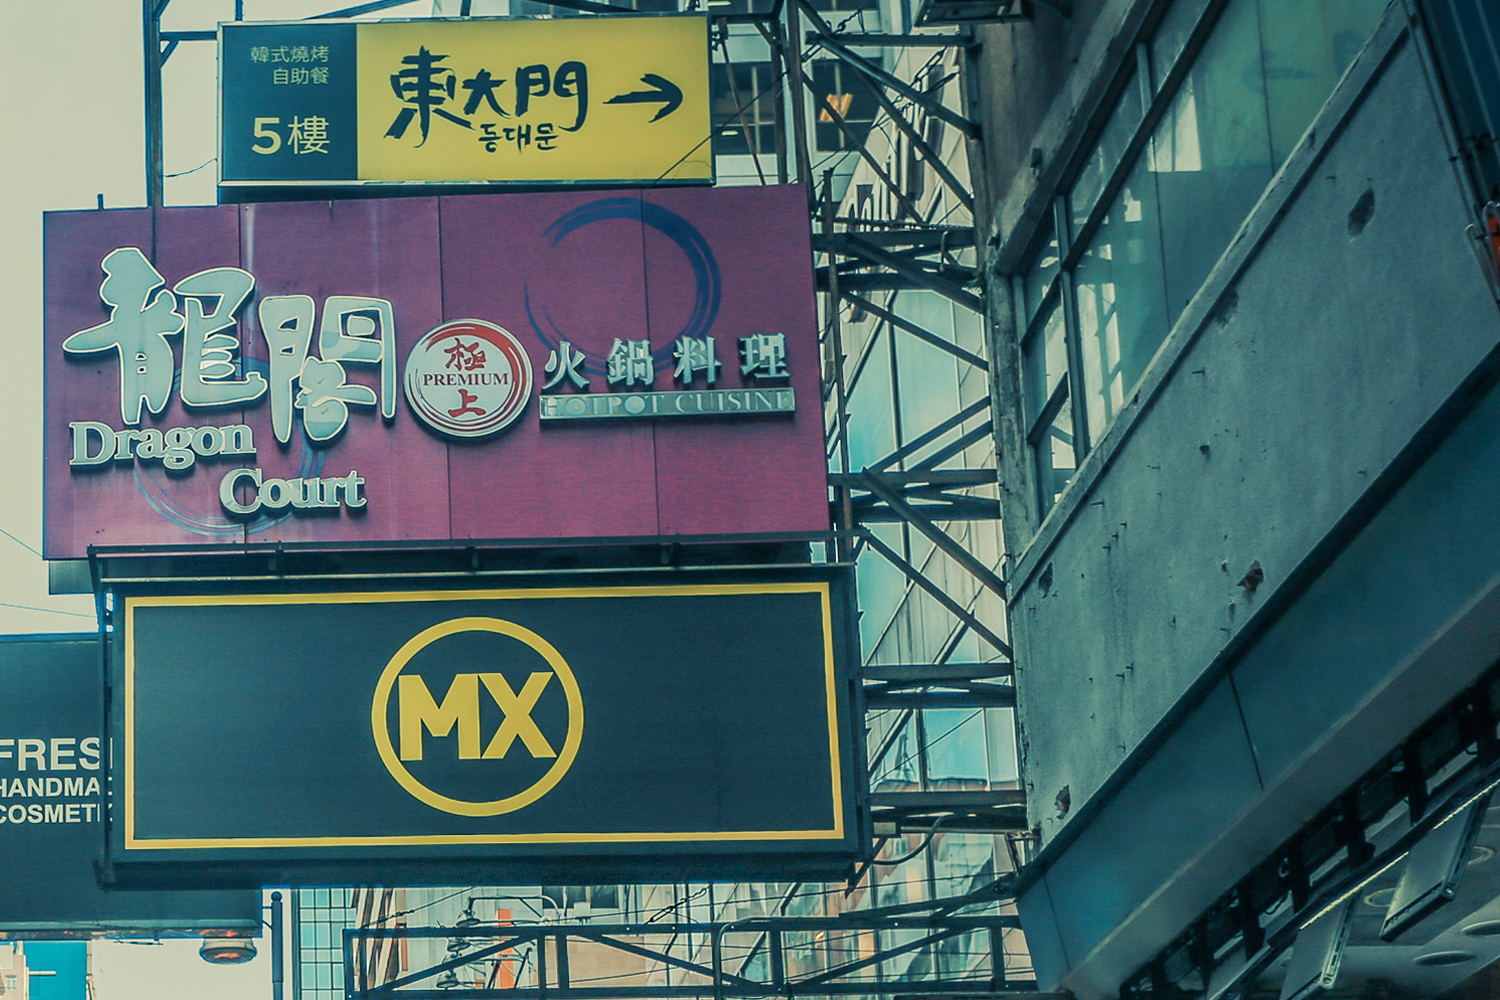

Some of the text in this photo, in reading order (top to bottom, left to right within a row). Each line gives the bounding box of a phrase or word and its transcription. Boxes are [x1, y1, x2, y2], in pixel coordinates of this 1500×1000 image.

[250, 44, 330, 64] 韓式燒烤
[273, 66, 330, 86] 自助餐
[384, 45, 589, 149] 東大門
[250, 115, 330, 155] 5樓
[478, 122, 559, 154] 동대문
[444, 338, 486, 372] 極
[541, 332, 792, 391] 火鍋料理
[422, 371, 510, 387] PREMIUM
[447, 388, 487, 418] 上
[542, 388, 793, 418] HOTPOT CUISINE
[68, 420, 257, 470] Dragon
[218, 468, 368, 515] Court
[398, 671, 558, 761] MX
